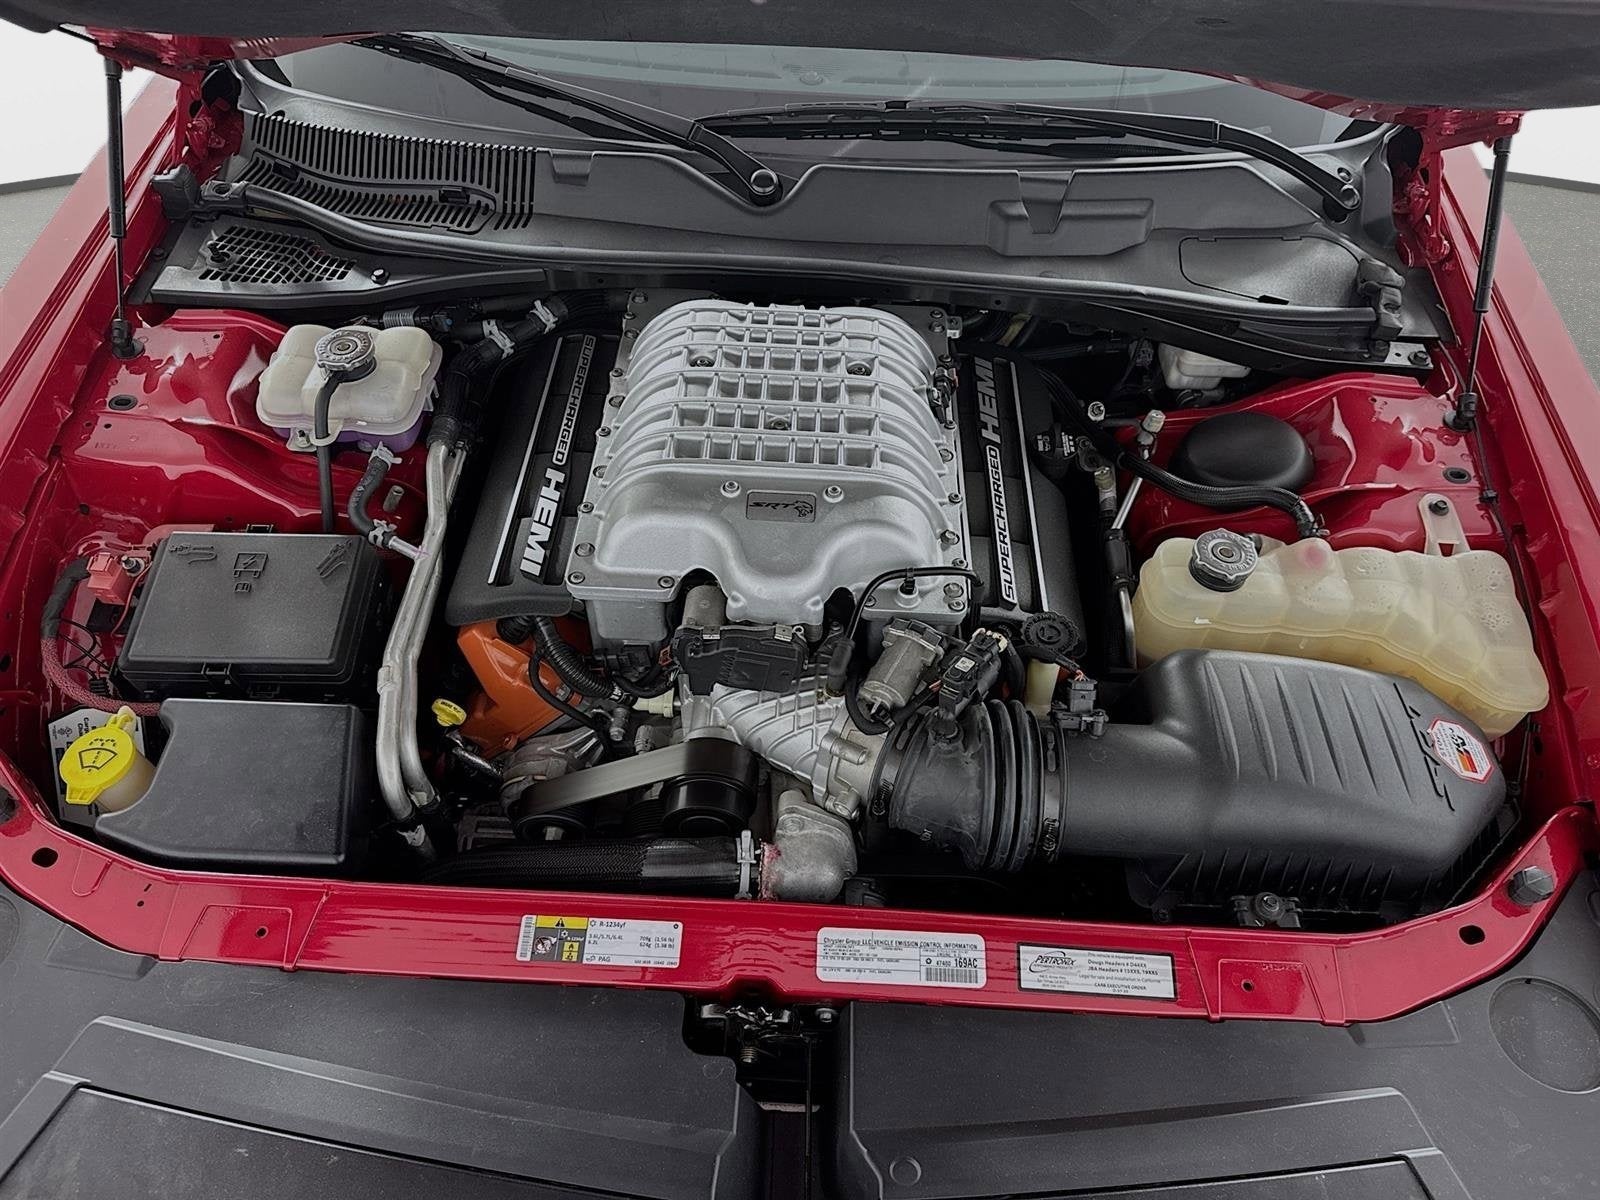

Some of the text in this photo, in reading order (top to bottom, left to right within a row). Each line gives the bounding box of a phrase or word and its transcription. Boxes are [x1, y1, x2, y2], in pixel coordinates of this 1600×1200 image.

[520, 336, 595, 576] SUPERCHARGED HEMI
[749, 502, 795, 510] SRT
[974, 356, 1015, 602] SUPERCHARGED HEMI
[954, 958, 978, 968] 169AC
